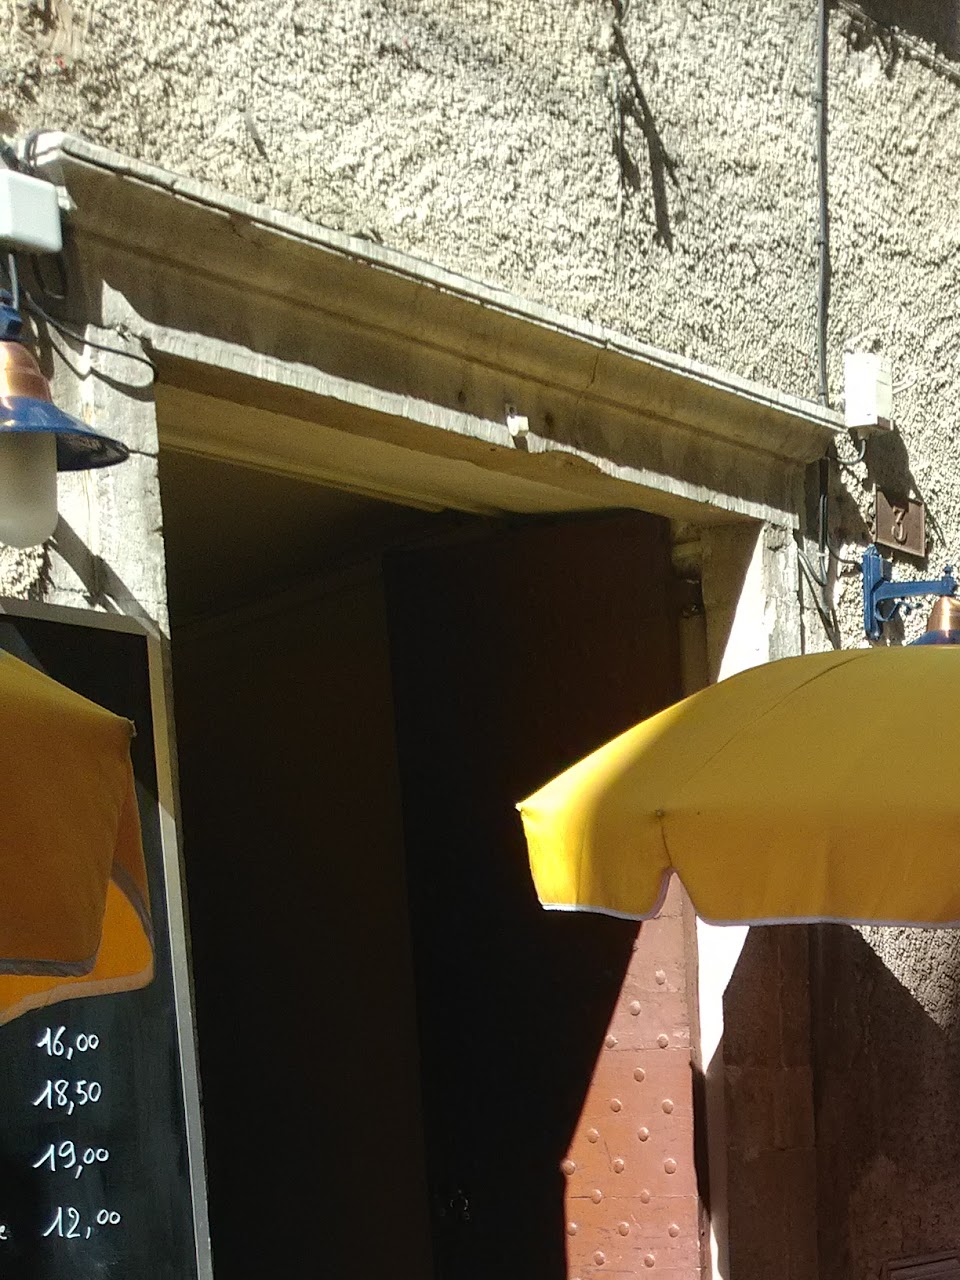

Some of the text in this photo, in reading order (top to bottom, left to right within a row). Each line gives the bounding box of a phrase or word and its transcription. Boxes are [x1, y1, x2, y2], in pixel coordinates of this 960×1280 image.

[891, 505, 907, 545] 3
[36, 1026, 99, 1060] 16,00
[33, 1080, 101, 1115] 18,50
[32, 1141, 109, 1179] 19,00
[42, 1206, 120, 1239] 12,00
